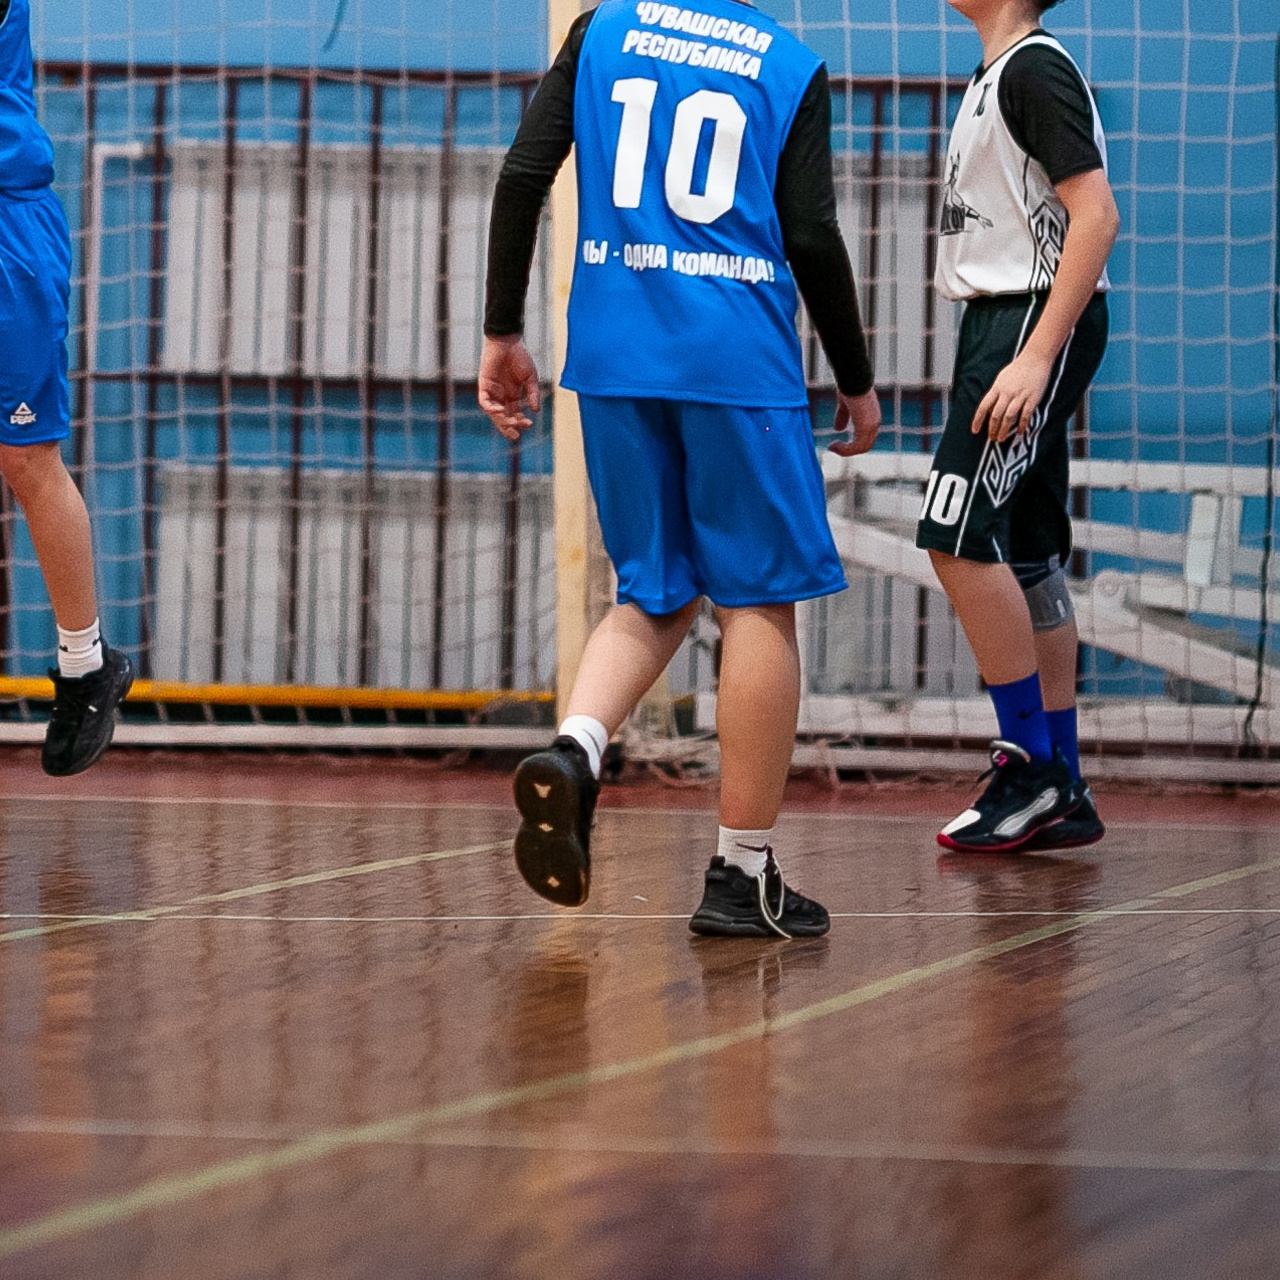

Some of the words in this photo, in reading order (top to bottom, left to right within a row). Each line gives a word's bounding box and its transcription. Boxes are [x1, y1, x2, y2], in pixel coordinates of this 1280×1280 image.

[635, 1, 774, 54] ЧУВАШСКАЯ
[622, 29, 763, 80] РЕСПУБЛИКА
[610, 77, 748, 225] 10
[623, 243, 668, 272] ОДНА
[672, 249, 775, 284] КОМАНДА!
